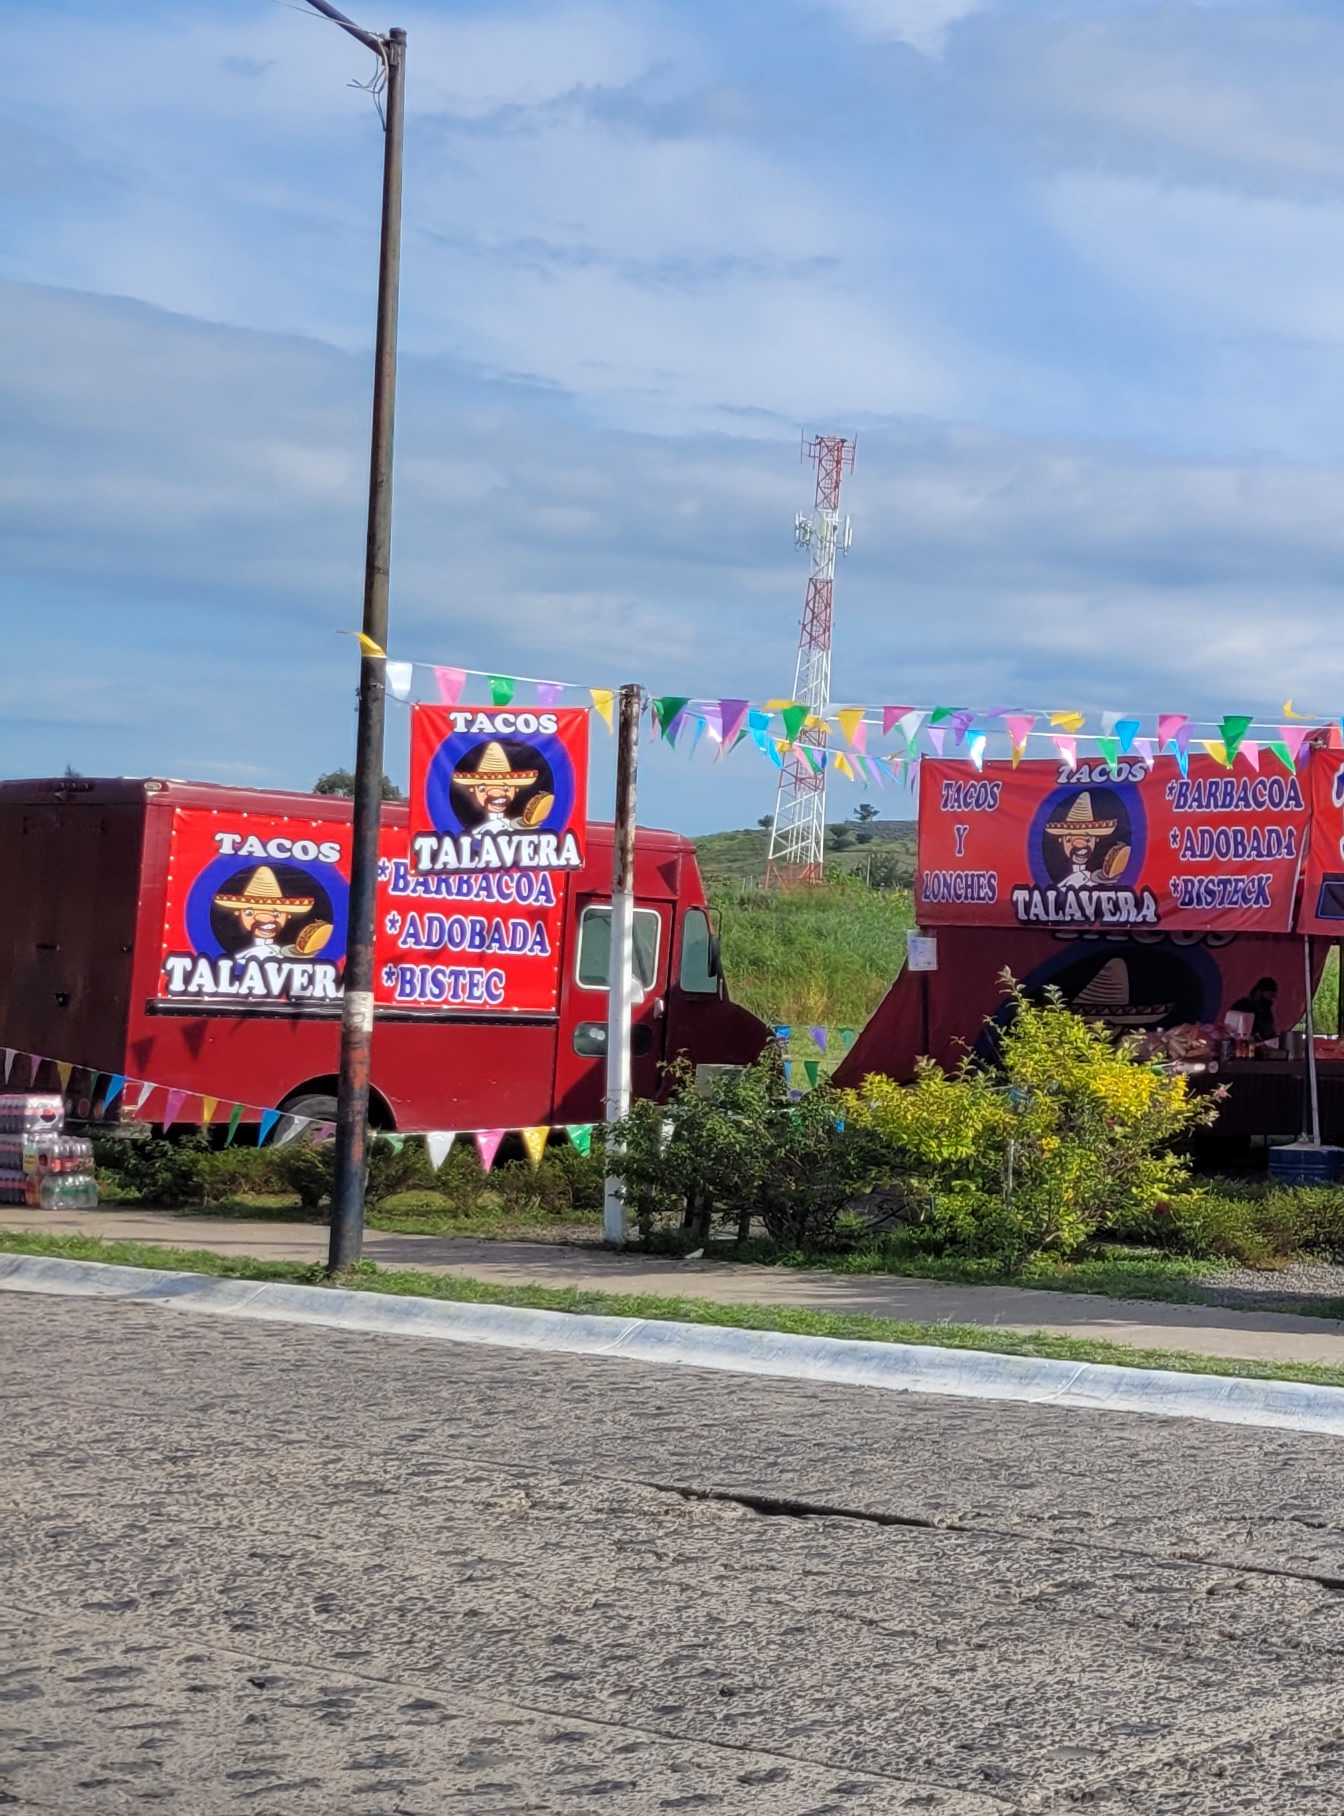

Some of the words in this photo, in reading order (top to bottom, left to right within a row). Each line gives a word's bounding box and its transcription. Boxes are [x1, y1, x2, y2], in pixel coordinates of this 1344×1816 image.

[449, 712, 558, 734] TACOS
[1057, 763, 1147, 783] TACOS
[941, 780, 1003, 811] TACOS
[214, 833, 341, 863] TACOS
[414, 833, 580, 870] TALAVERA
[954, 825, 969, 857] Y
[922, 871, 997, 903] LONCHES
[1013, 890, 1157, 923] TALAVERA
[166, 957, 345, 997] TALAVER
